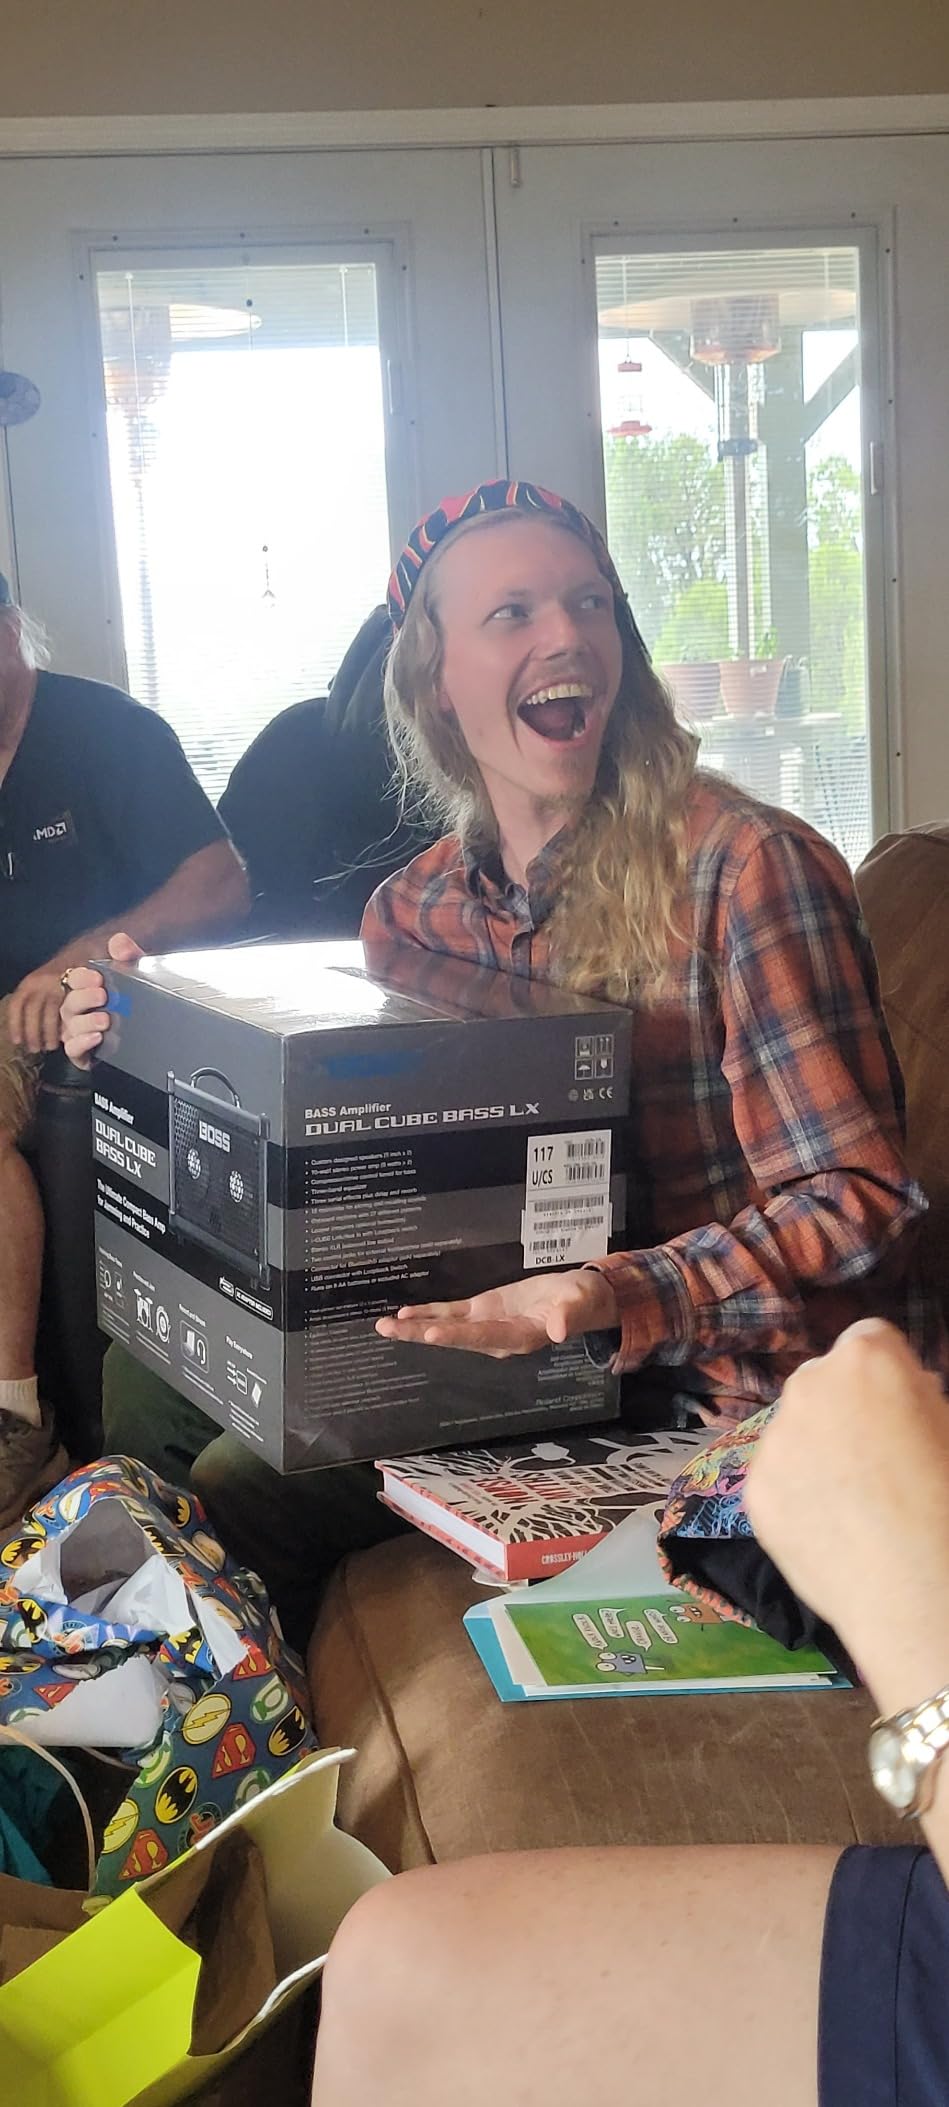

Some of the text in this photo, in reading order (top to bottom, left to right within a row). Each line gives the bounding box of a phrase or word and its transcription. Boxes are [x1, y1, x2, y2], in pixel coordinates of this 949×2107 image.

[304, 1103, 392, 1119] BASS Amplifier
[305, 1102, 539, 1136] DUAL CUBE BASS LX
[95, 1118, 157, 1168] DUAL CUBE
[199, 1119, 231, 1153] BOSS
[95, 1136, 142, 1179] BASS LX
[533, 1145, 554, 1163] 117
[531, 1168, 554, 1188] U/CS
[535, 1254, 565, 1266] DCB-LX
[469, 1475, 541, 1505] NORSE
[510, 1472, 582, 1501] MYTHS
